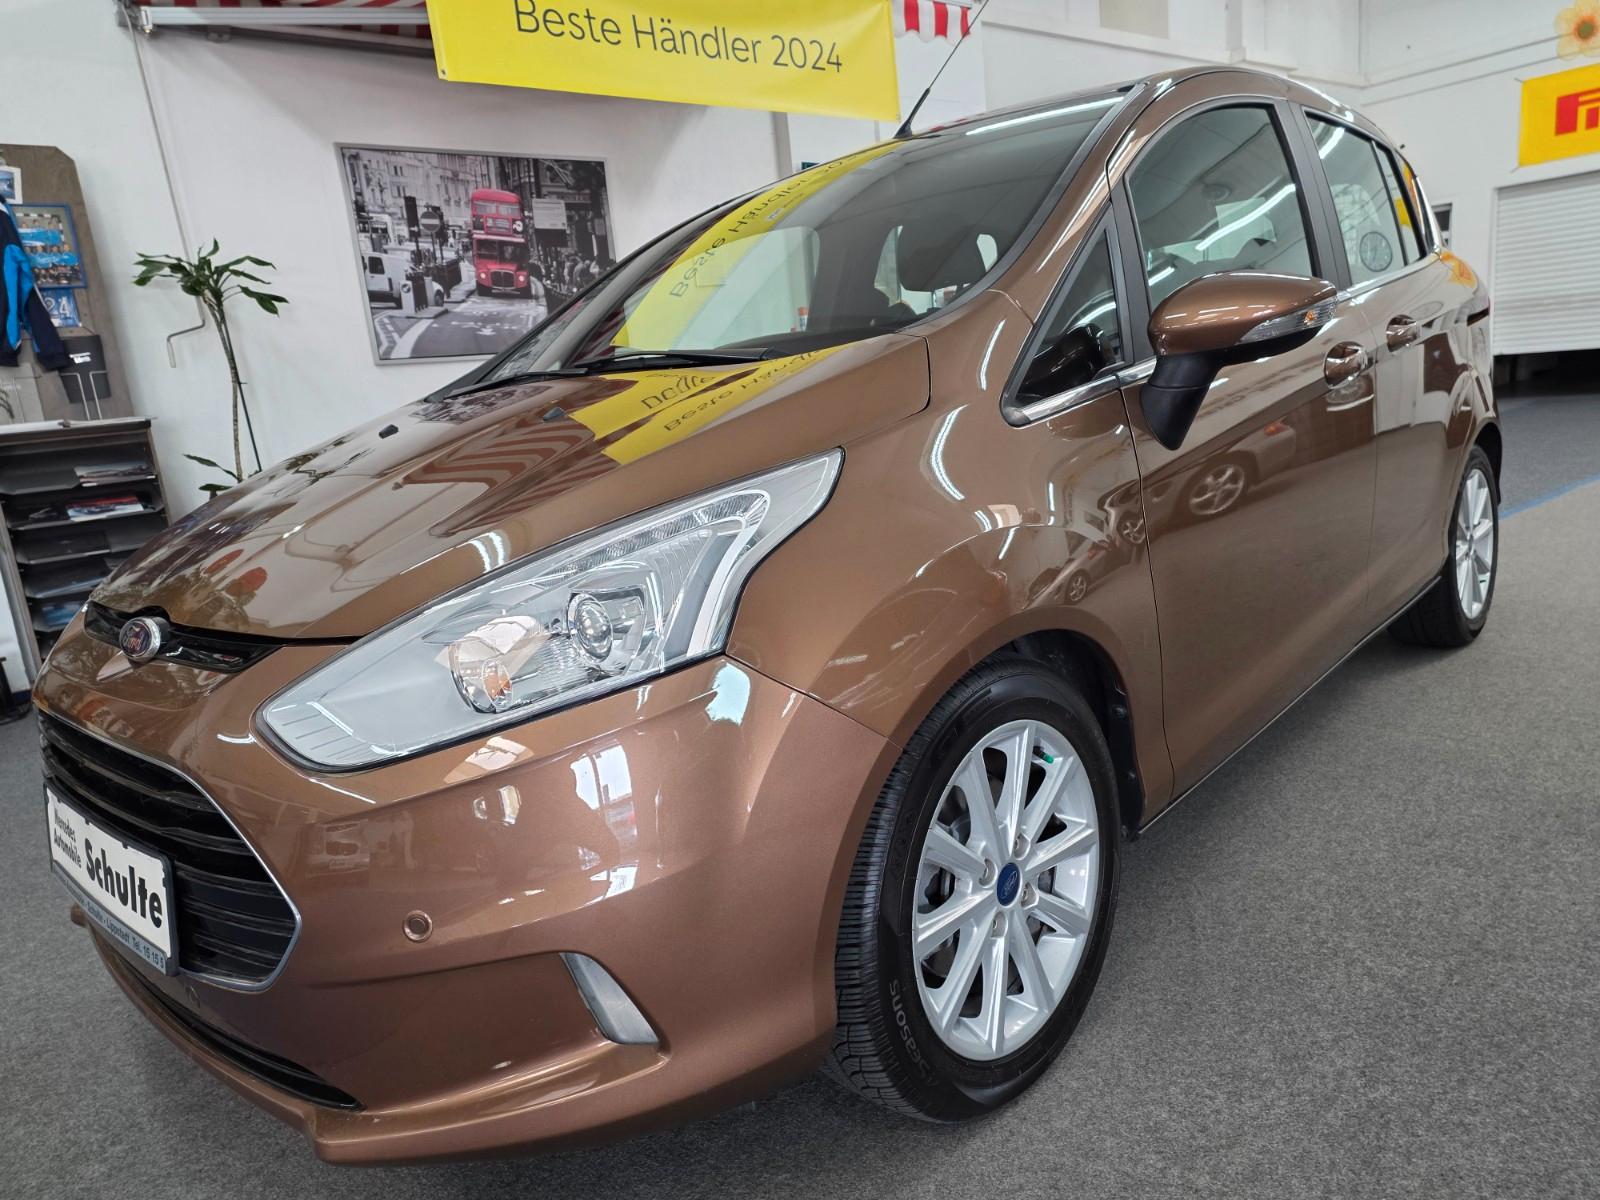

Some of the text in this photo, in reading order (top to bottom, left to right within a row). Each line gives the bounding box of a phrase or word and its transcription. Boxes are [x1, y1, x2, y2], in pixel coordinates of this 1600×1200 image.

[514, 0, 844, 74] Beste Händler 2024
[85, 837, 163, 928] Schulte
